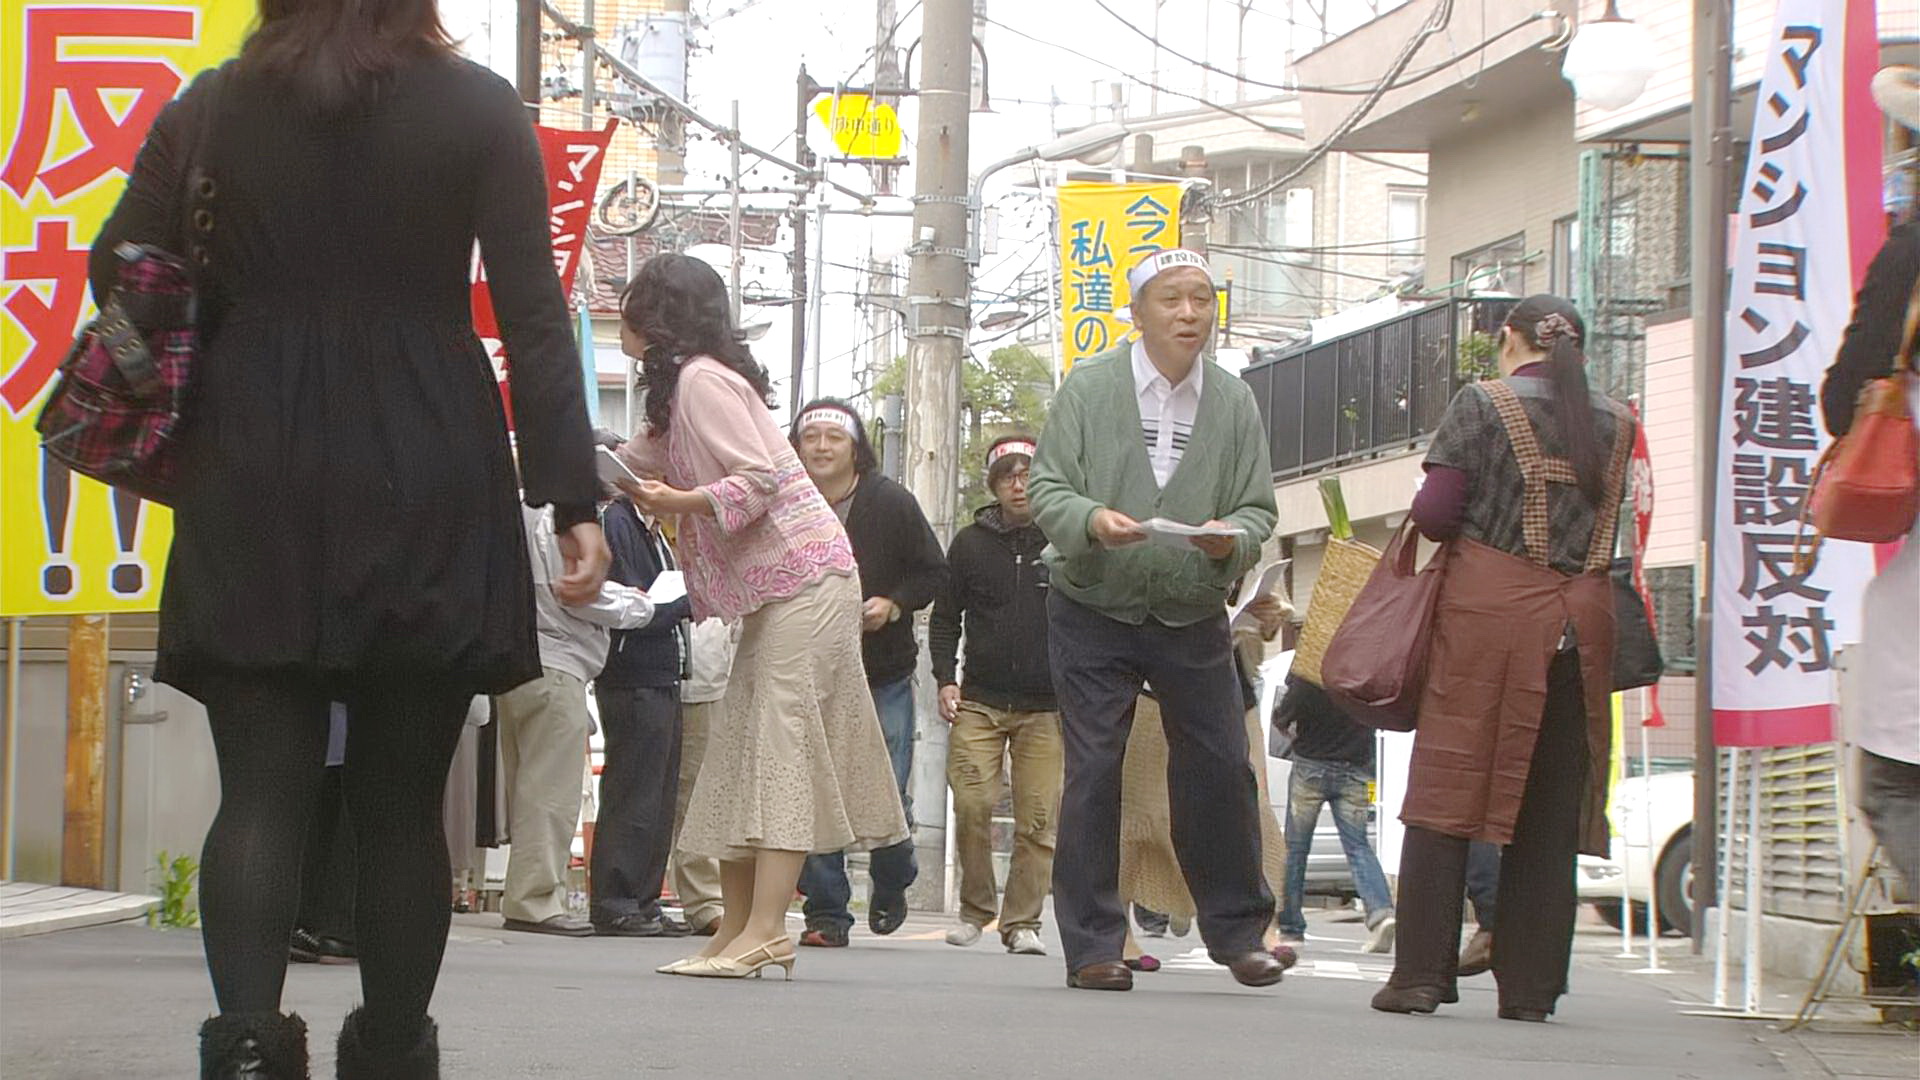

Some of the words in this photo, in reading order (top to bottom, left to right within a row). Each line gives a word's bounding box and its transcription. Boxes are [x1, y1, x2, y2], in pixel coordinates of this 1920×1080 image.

[1070, 220, 1114, 362] 私達の
[1732, 26, 1835, 676] マンション建設反対
